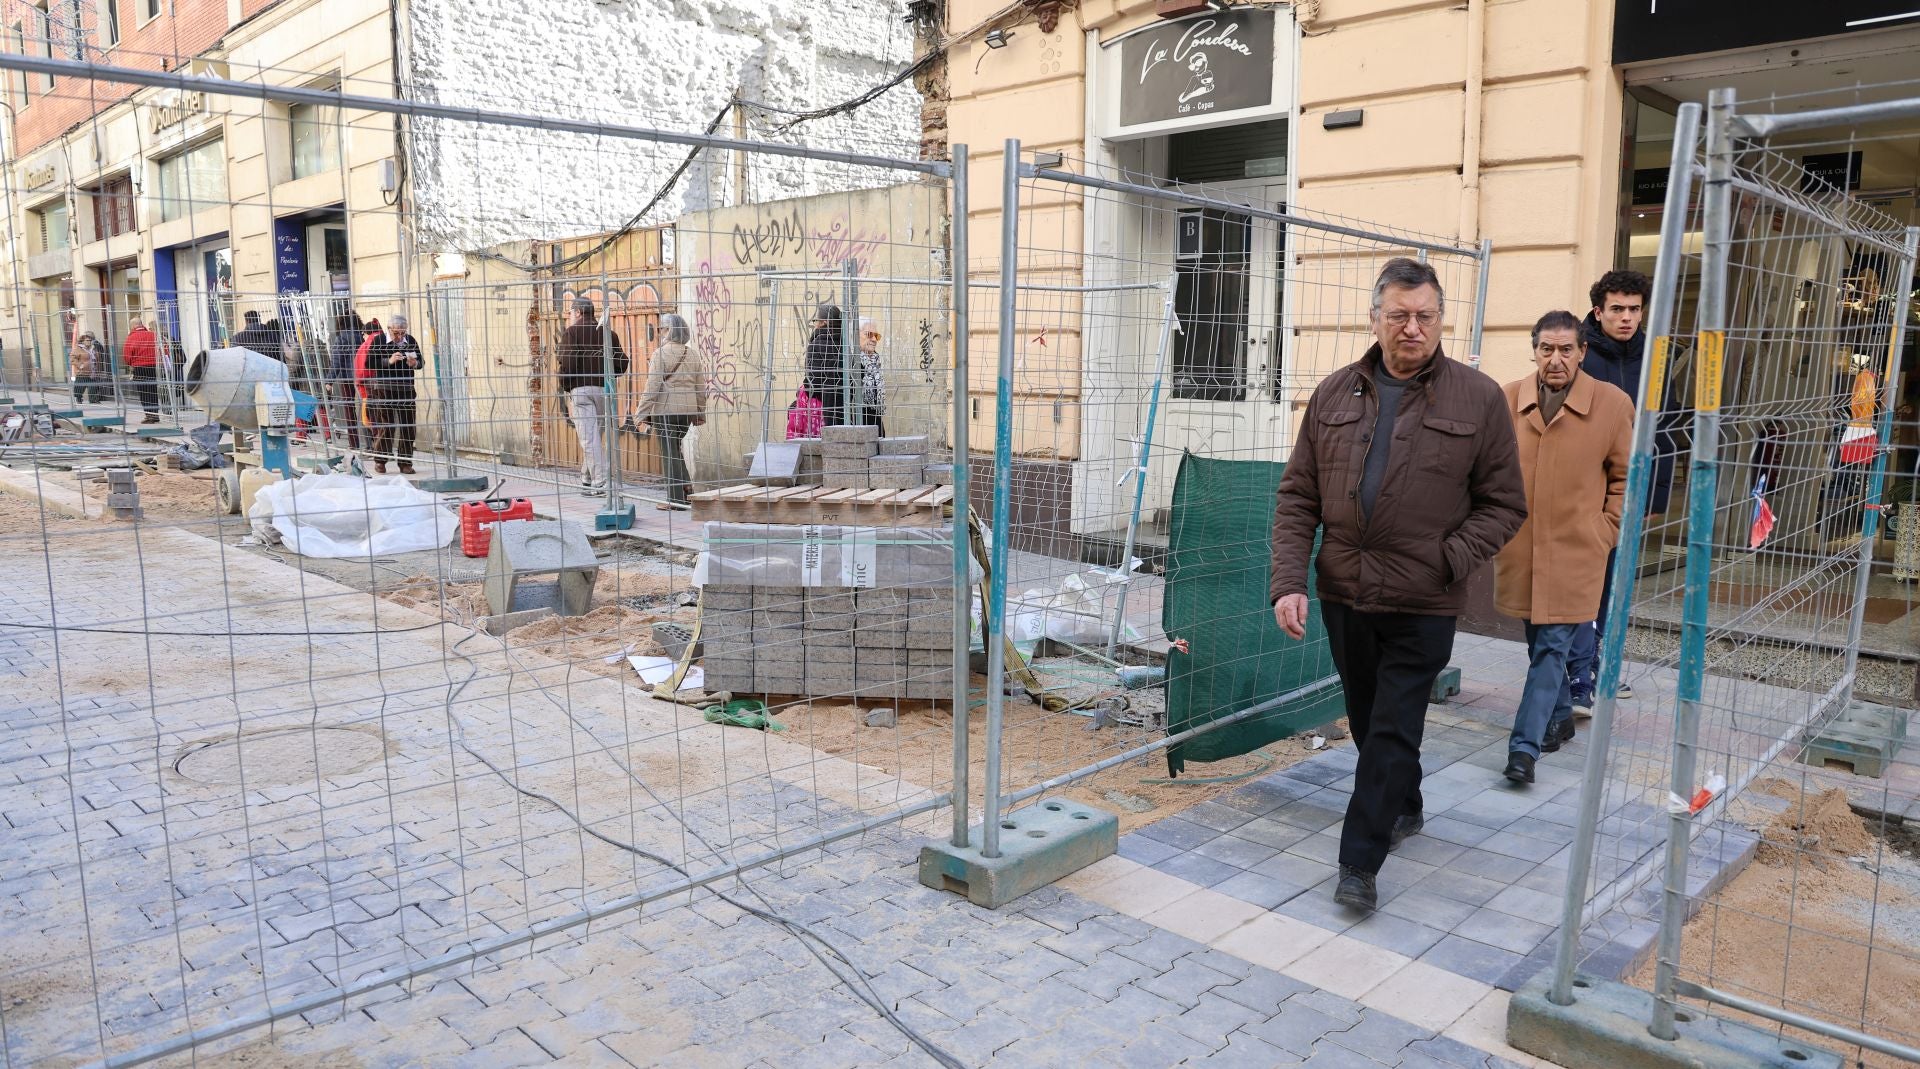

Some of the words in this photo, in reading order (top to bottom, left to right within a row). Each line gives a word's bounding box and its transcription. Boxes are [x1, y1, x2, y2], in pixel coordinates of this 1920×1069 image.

[1139, 38, 1169, 85] La
[1173, 19, 1253, 63] Condesa
[156, 90, 204, 131] Santander
[1178, 104, 1191, 113] Café
[1197, 101, 1215, 111] Copas
[1186, 221, 1195, 237] B
[804, 541, 819, 569] MATERIA
